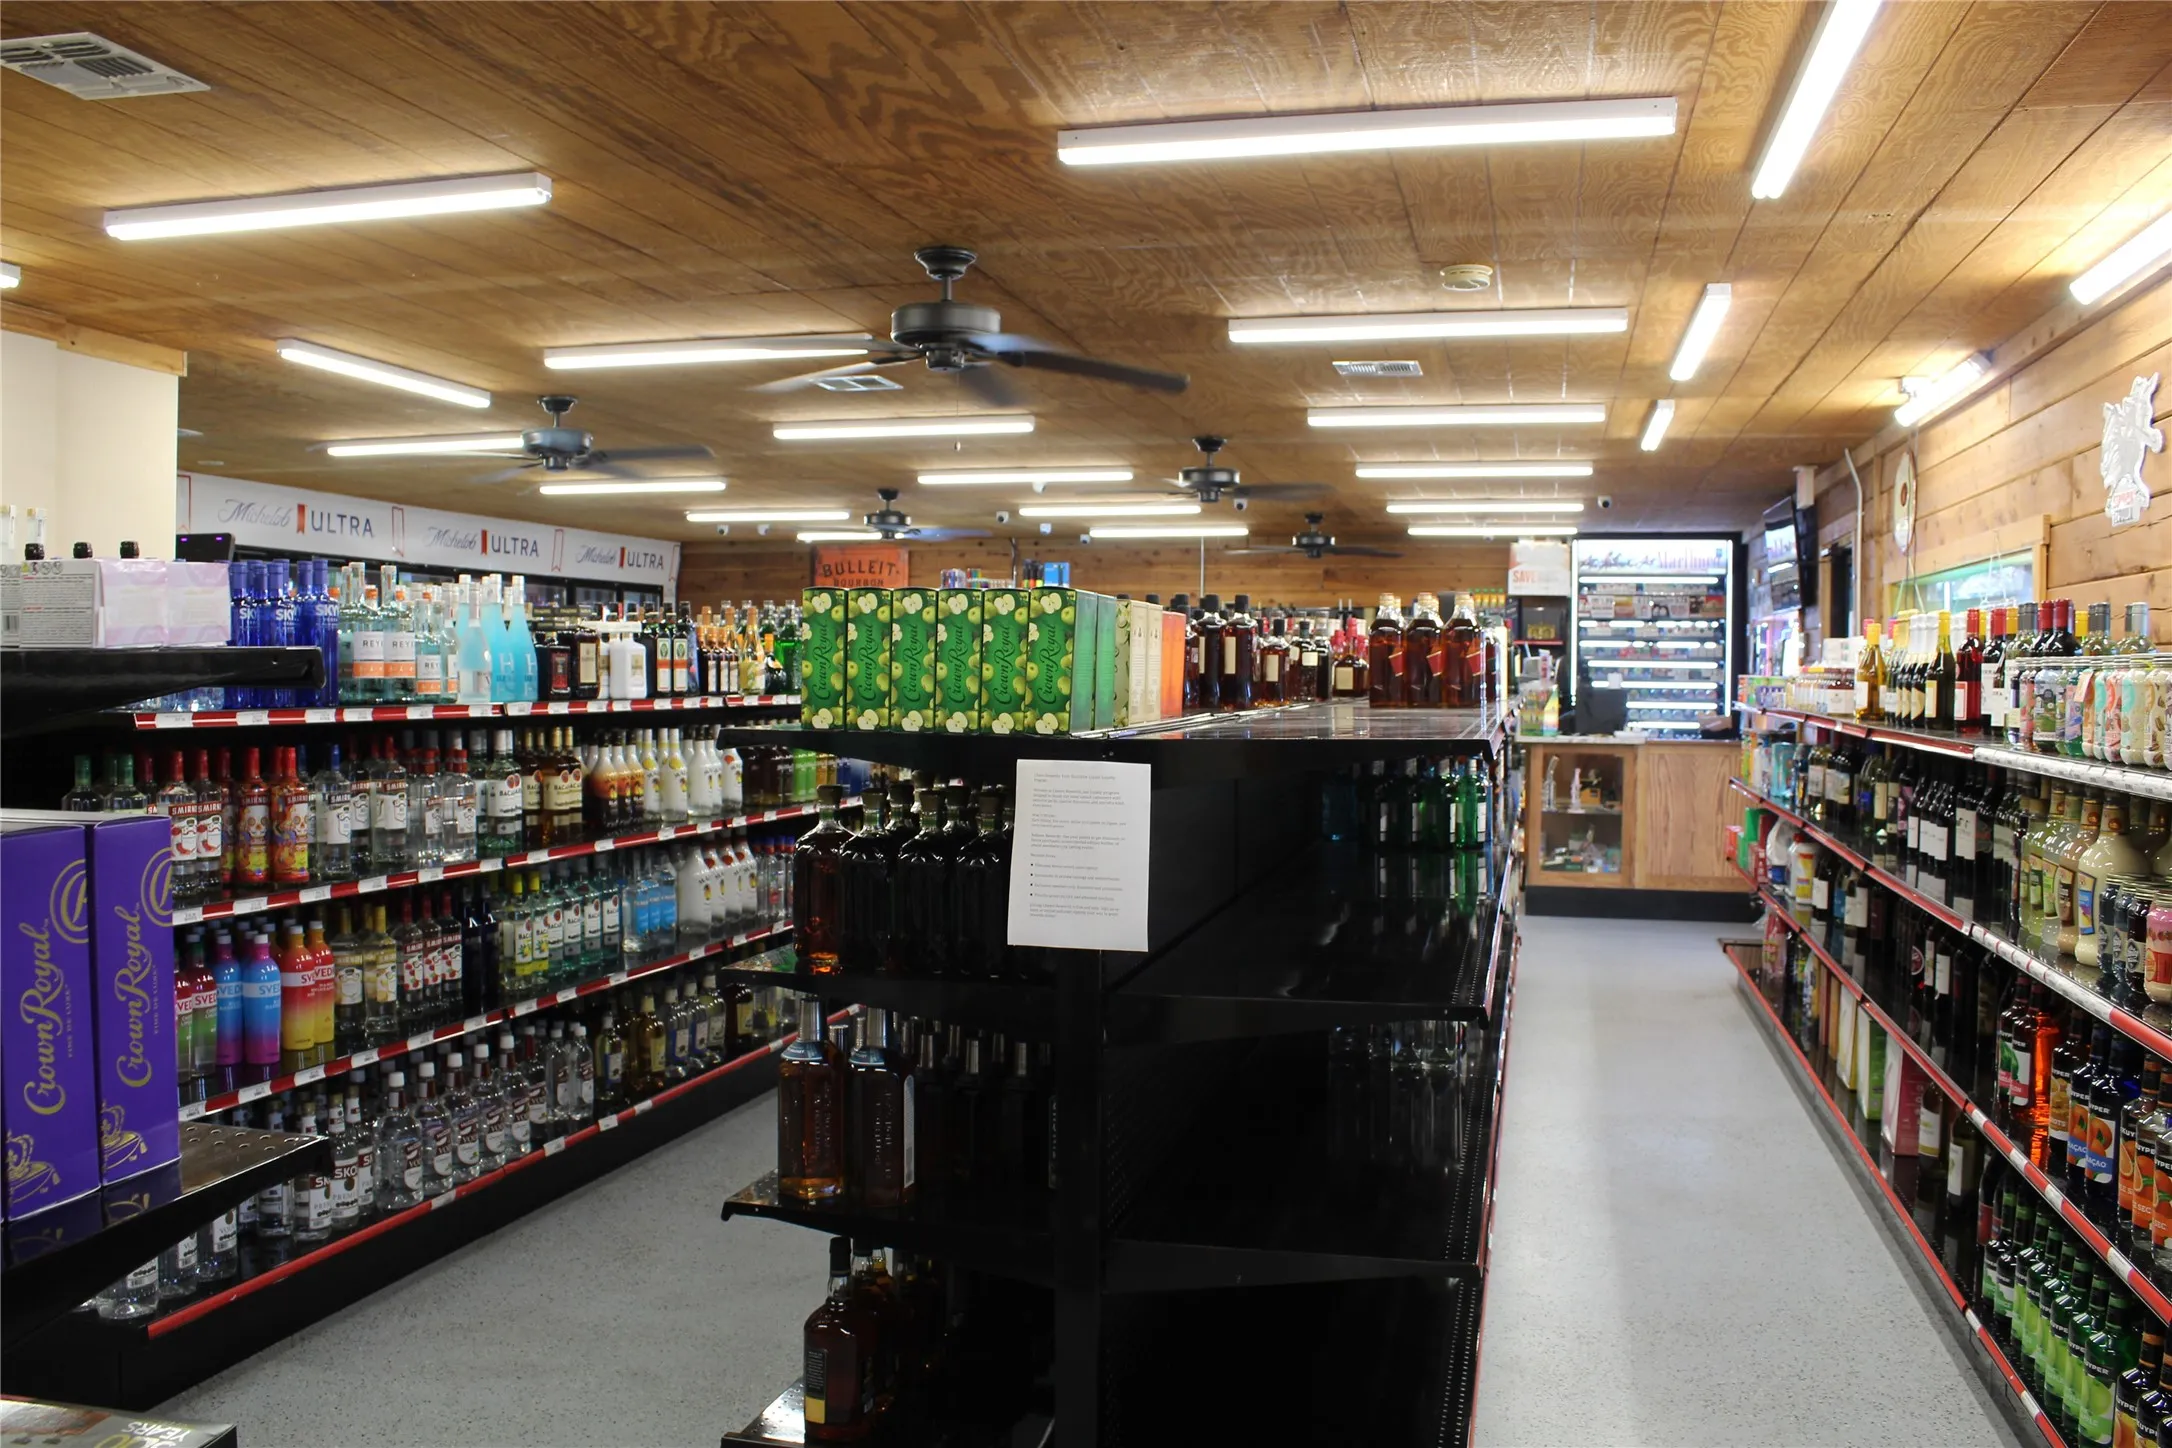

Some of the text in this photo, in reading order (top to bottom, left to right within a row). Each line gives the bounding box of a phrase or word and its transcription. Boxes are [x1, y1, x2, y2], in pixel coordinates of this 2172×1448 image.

[217, 499, 375, 538] Michelob ULTRA
[491, 535, 540, 558] ULTRA
[626, 552, 665, 570] ULTRA
[823, 559, 896, 578] BULLEIT
[812, 622, 832, 700] Crown Royal
[858, 623, 878, 702] Crown Royal
[903, 623, 924, 703] Crown Royal
[948, 623, 969, 704] Crown Royal
[993, 623, 1015, 705] Crown Royal
[1035, 623, 1060, 705] Crown Royal
[19, 922, 66, 1116] Crown Royal
[114, 905, 153, 1088] Crown Royal
[121, 1421, 191, 1442] YEARS
